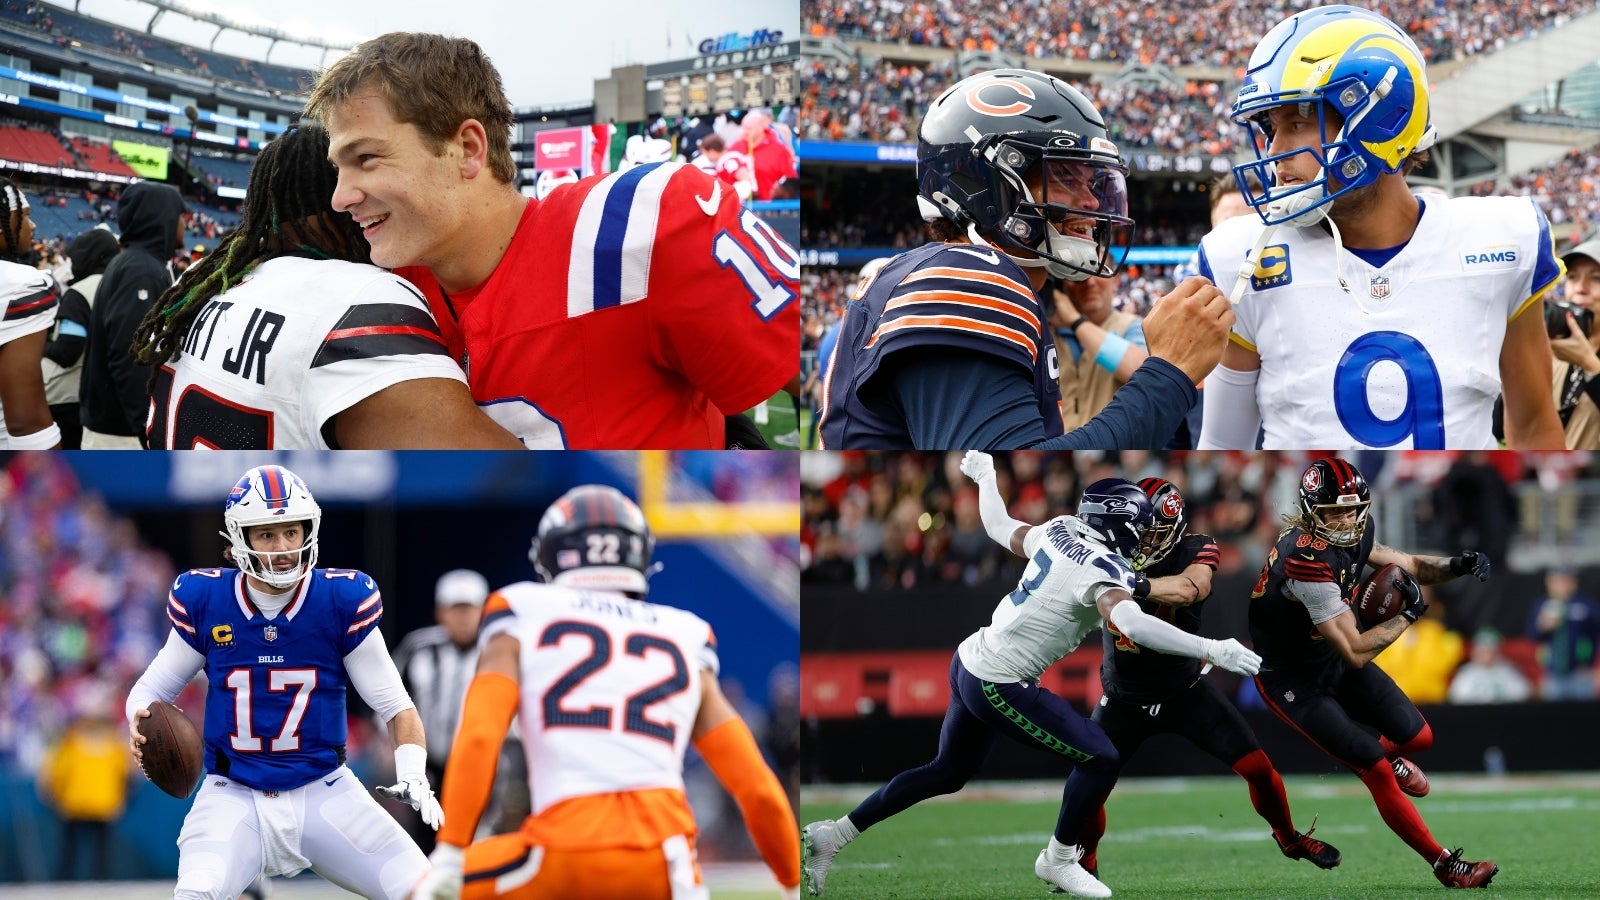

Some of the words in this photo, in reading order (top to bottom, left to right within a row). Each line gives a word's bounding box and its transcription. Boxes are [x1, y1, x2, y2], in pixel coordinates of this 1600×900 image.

[692, 44, 789, 70] STADIUM
[698, 28, 783, 54] Gillette
[965, 79, 1036, 117] C
[711, 207, 800, 323] 10
[1252, 246, 1287, 279] C
[1465, 251, 1516, 265] RAMS
[1371, 284, 1390, 297] NFL
[222, 307, 286, 386] JR
[1334, 331, 1445, 450] 9
[586, 534, 620, 564] 22
[1009, 547, 1053, 607] 3
[212, 624, 233, 643] C
[258, 655, 284, 663] BILLS
[538, 620, 691, 747] 22
[226, 667, 318, 752] 17
